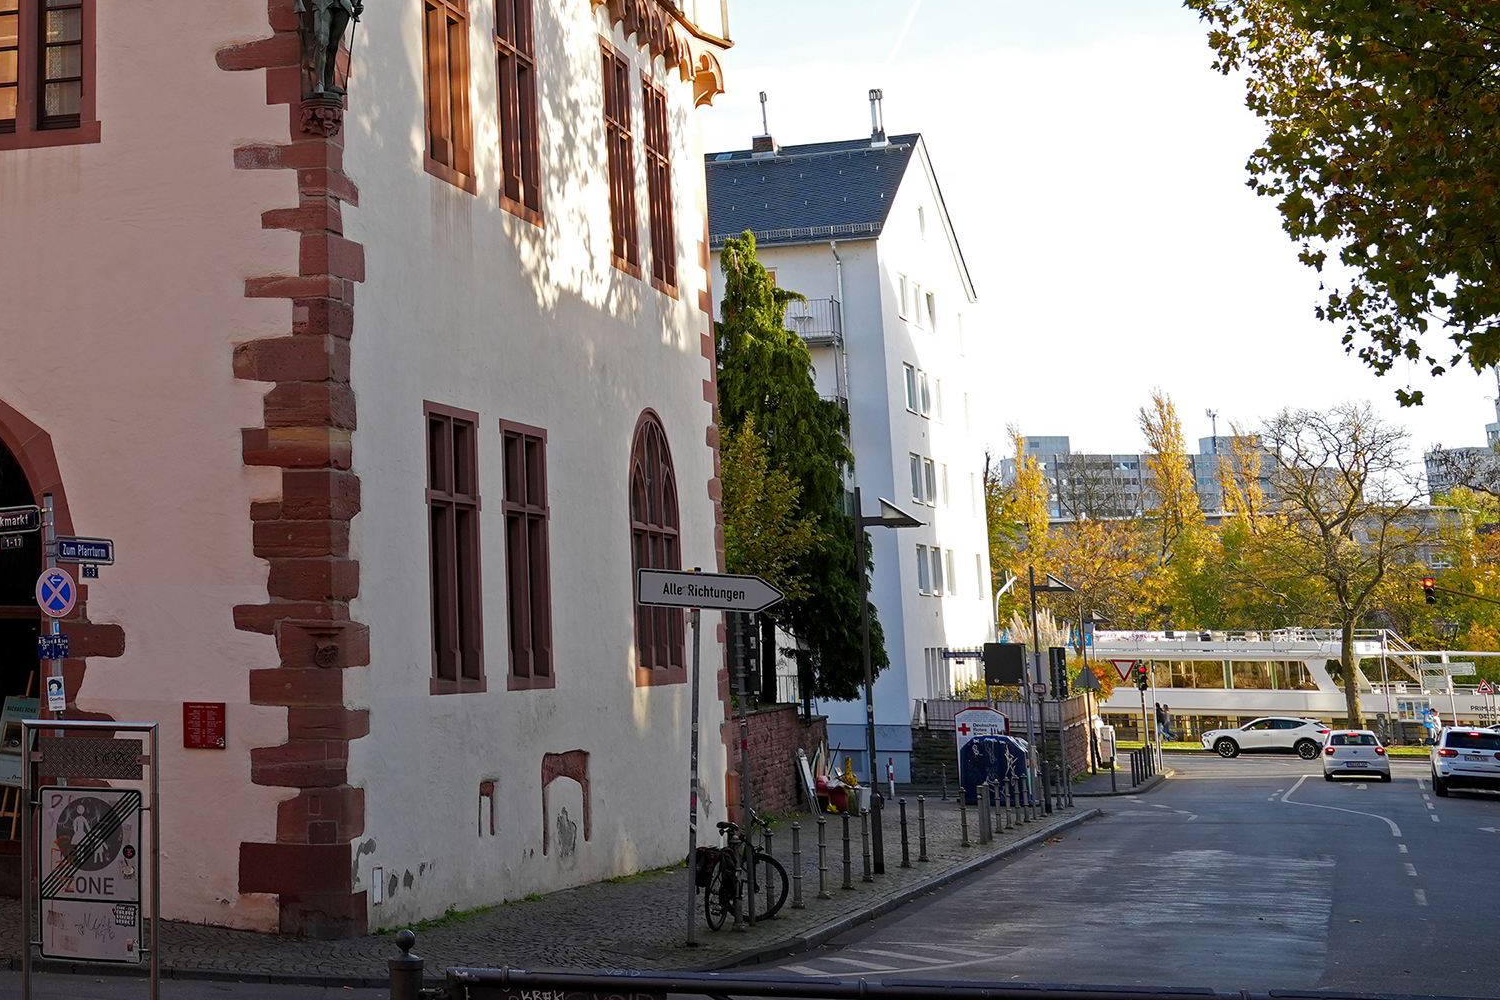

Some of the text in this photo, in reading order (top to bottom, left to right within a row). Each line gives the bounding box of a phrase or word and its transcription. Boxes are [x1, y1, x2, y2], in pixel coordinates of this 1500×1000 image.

[62, 543, 107, 558] Zum Pfarrturm
[663, 582, 745, 602] Alle Richtungen
